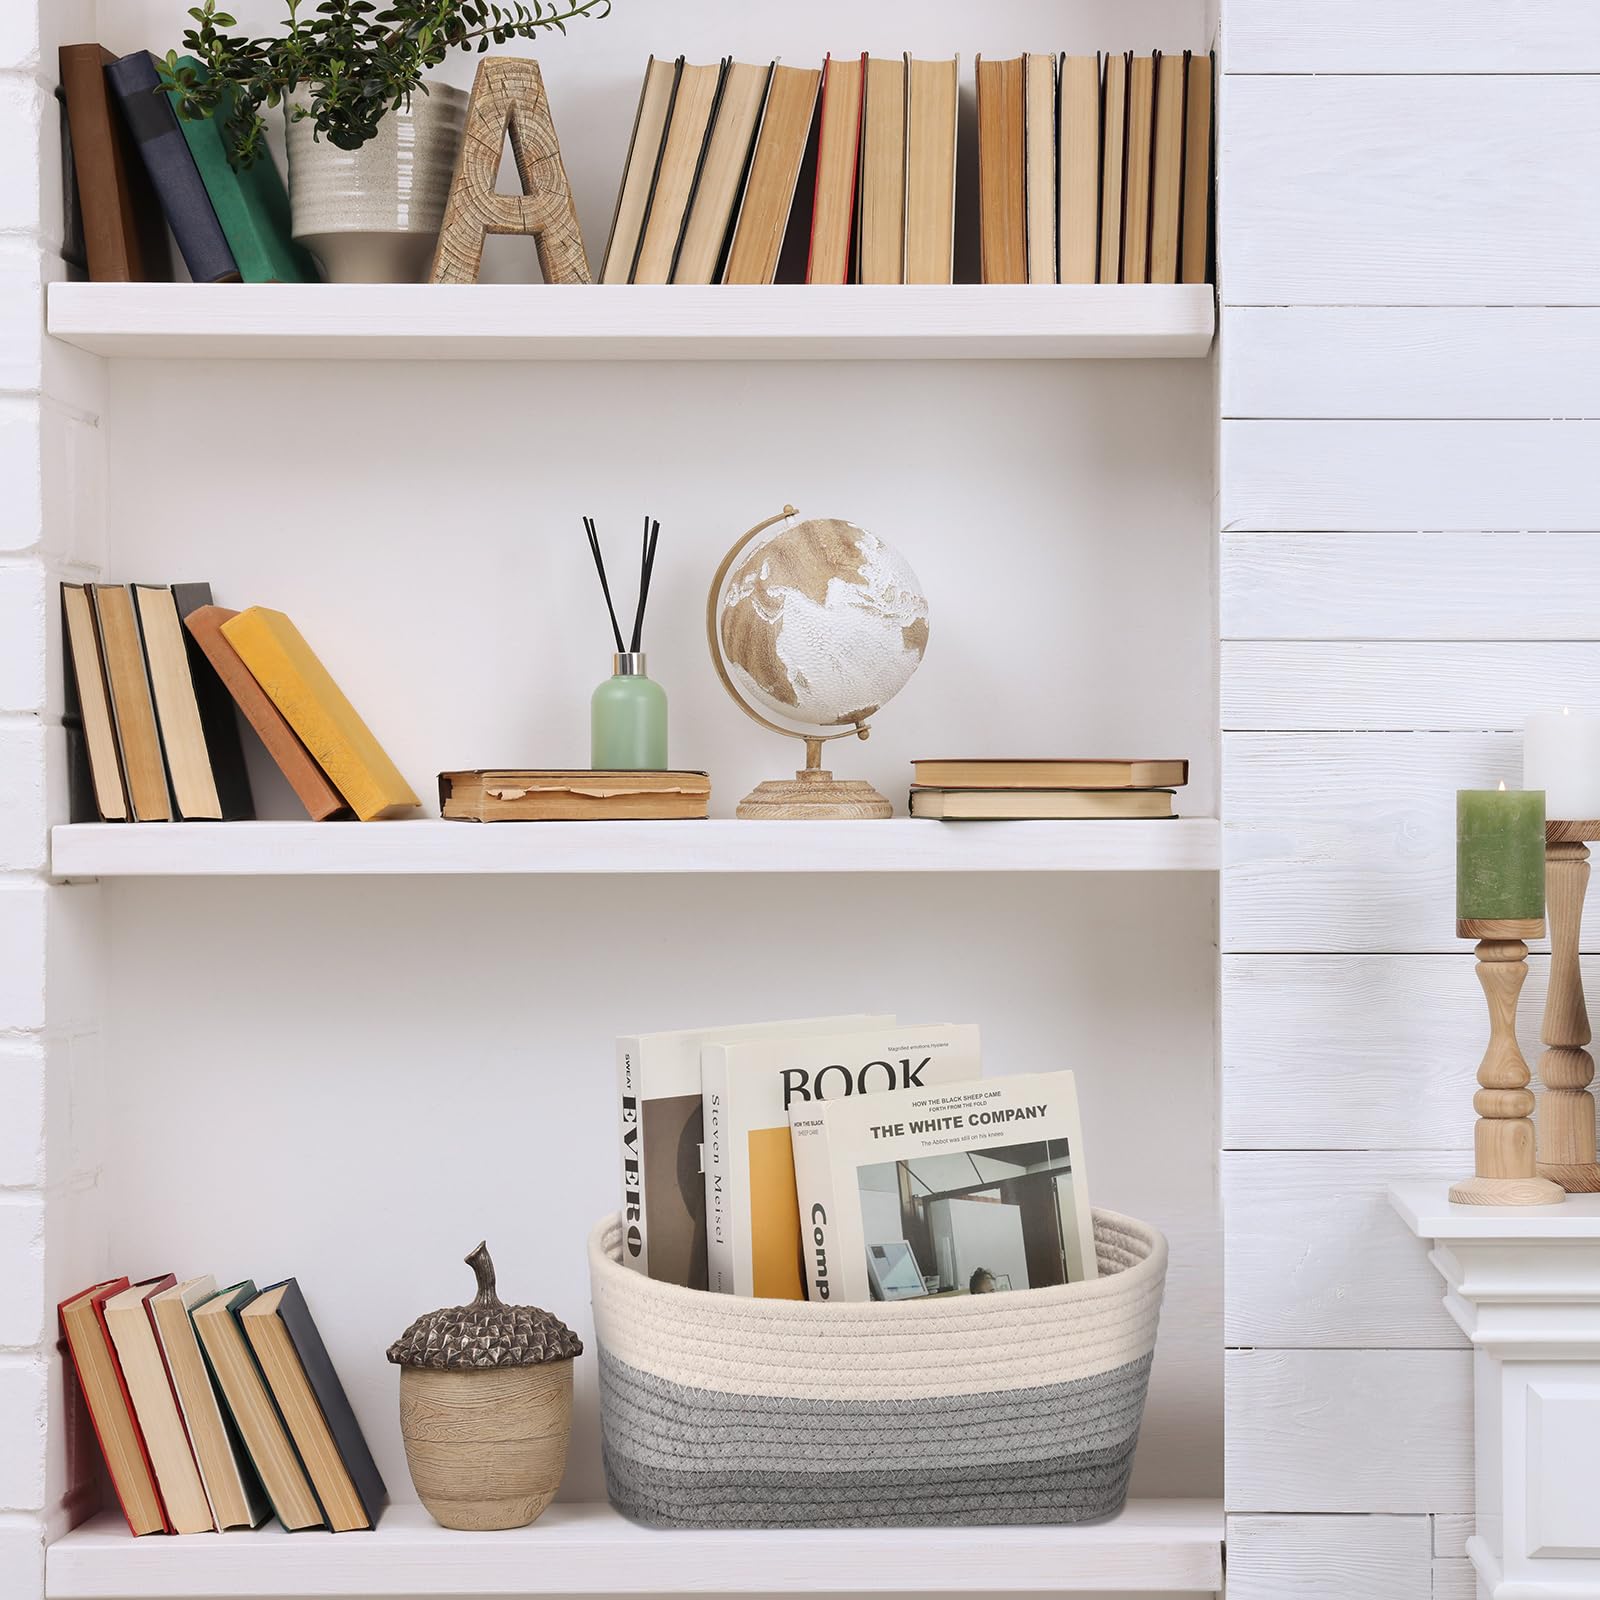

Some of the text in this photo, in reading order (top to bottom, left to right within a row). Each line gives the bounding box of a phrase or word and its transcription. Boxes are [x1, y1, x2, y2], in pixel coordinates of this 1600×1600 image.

[429, 56, 592, 284] A
[624, 1053, 632, 1090] SWEAT
[779, 1056, 931, 1112] BOOK
[912, 1090, 1002, 1108] HOW THE BLACK SHEEP CAME
[870, 1104, 1048, 1139] THE WHITE COMPANY
[622, 1095, 642, 1258] EVERO
[711, 1093, 724, 1244] Steven Meisel
[811, 1202, 830, 1300] Comp
